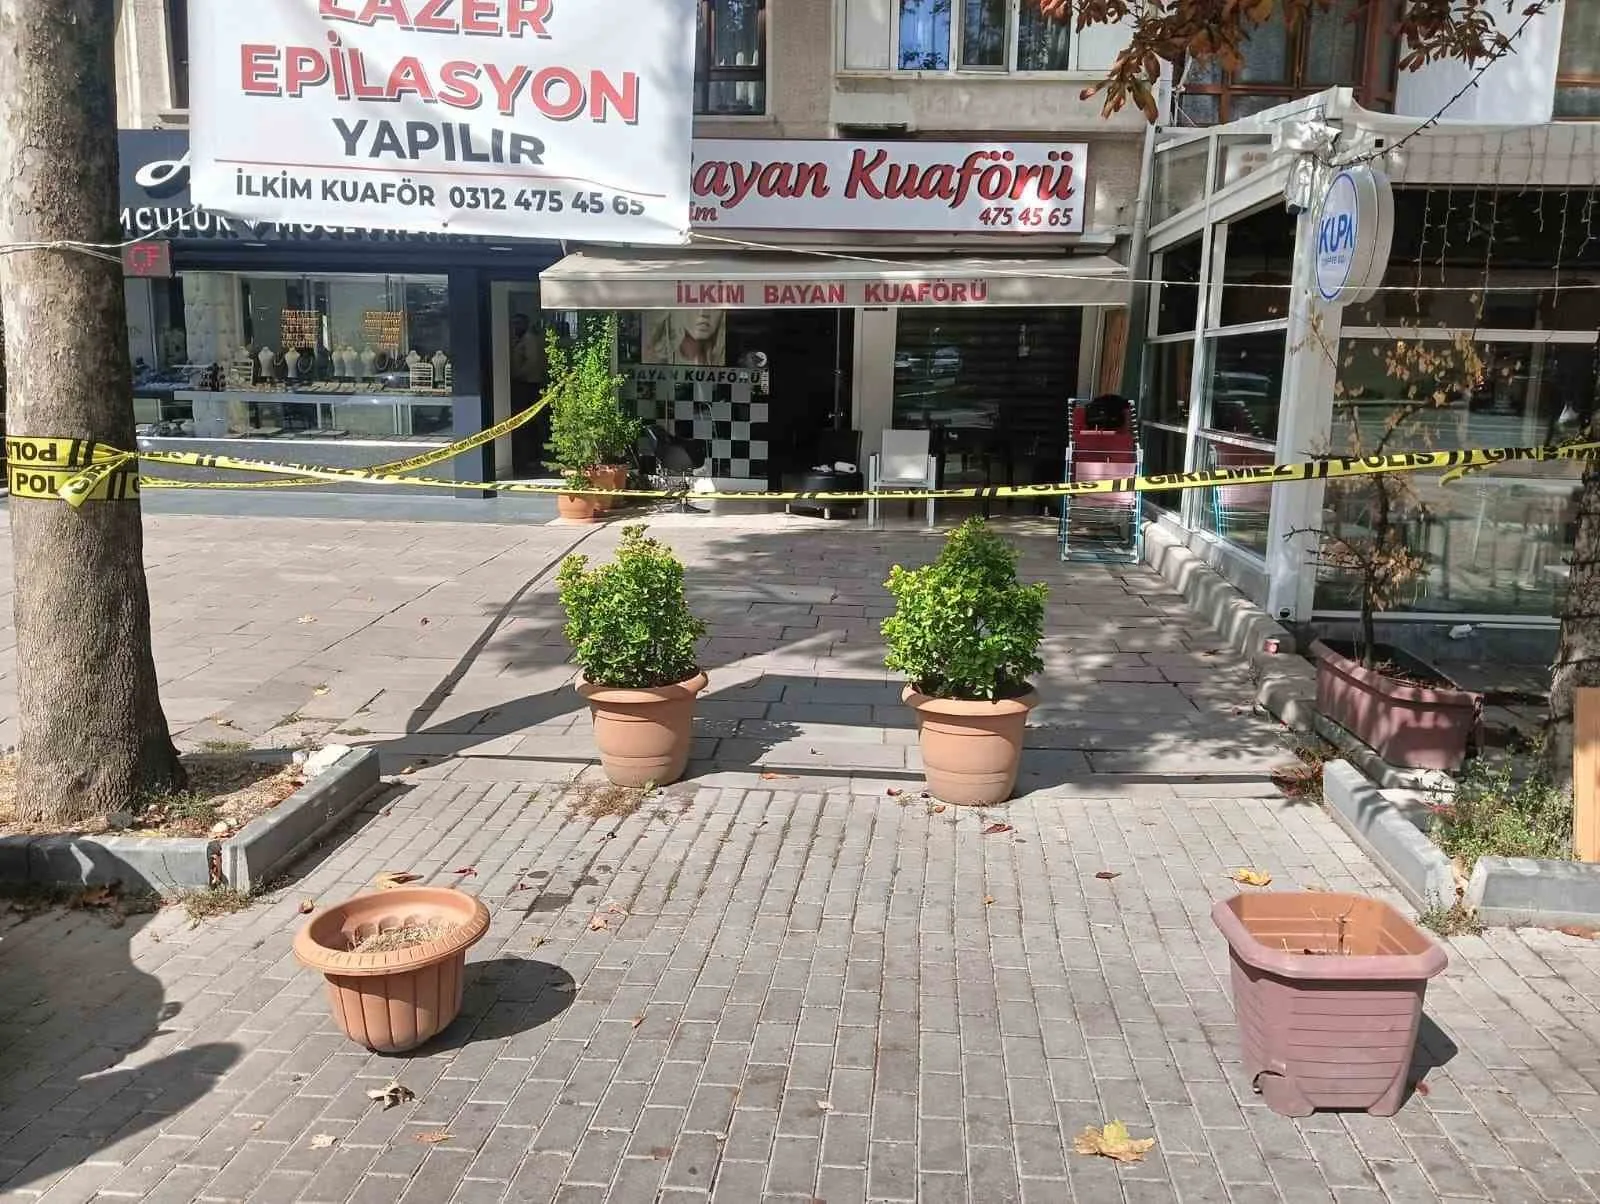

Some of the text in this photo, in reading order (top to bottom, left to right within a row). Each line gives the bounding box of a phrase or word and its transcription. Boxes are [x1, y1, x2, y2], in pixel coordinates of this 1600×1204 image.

[241, 30, 639, 124] EPİLASYON
[333, 118, 545, 165] YAPILIR
[236, 168, 645, 216] İLKİM KUAFÖR 0312 475 45 65
[691, 148, 1074, 209] ayan Kuaförü
[979, 207, 1074, 226] 475 45 65
[676, 278, 988, 304] İLKİM BAYAN KUAFÖRÜ
[16, 472, 58, 494] POL
